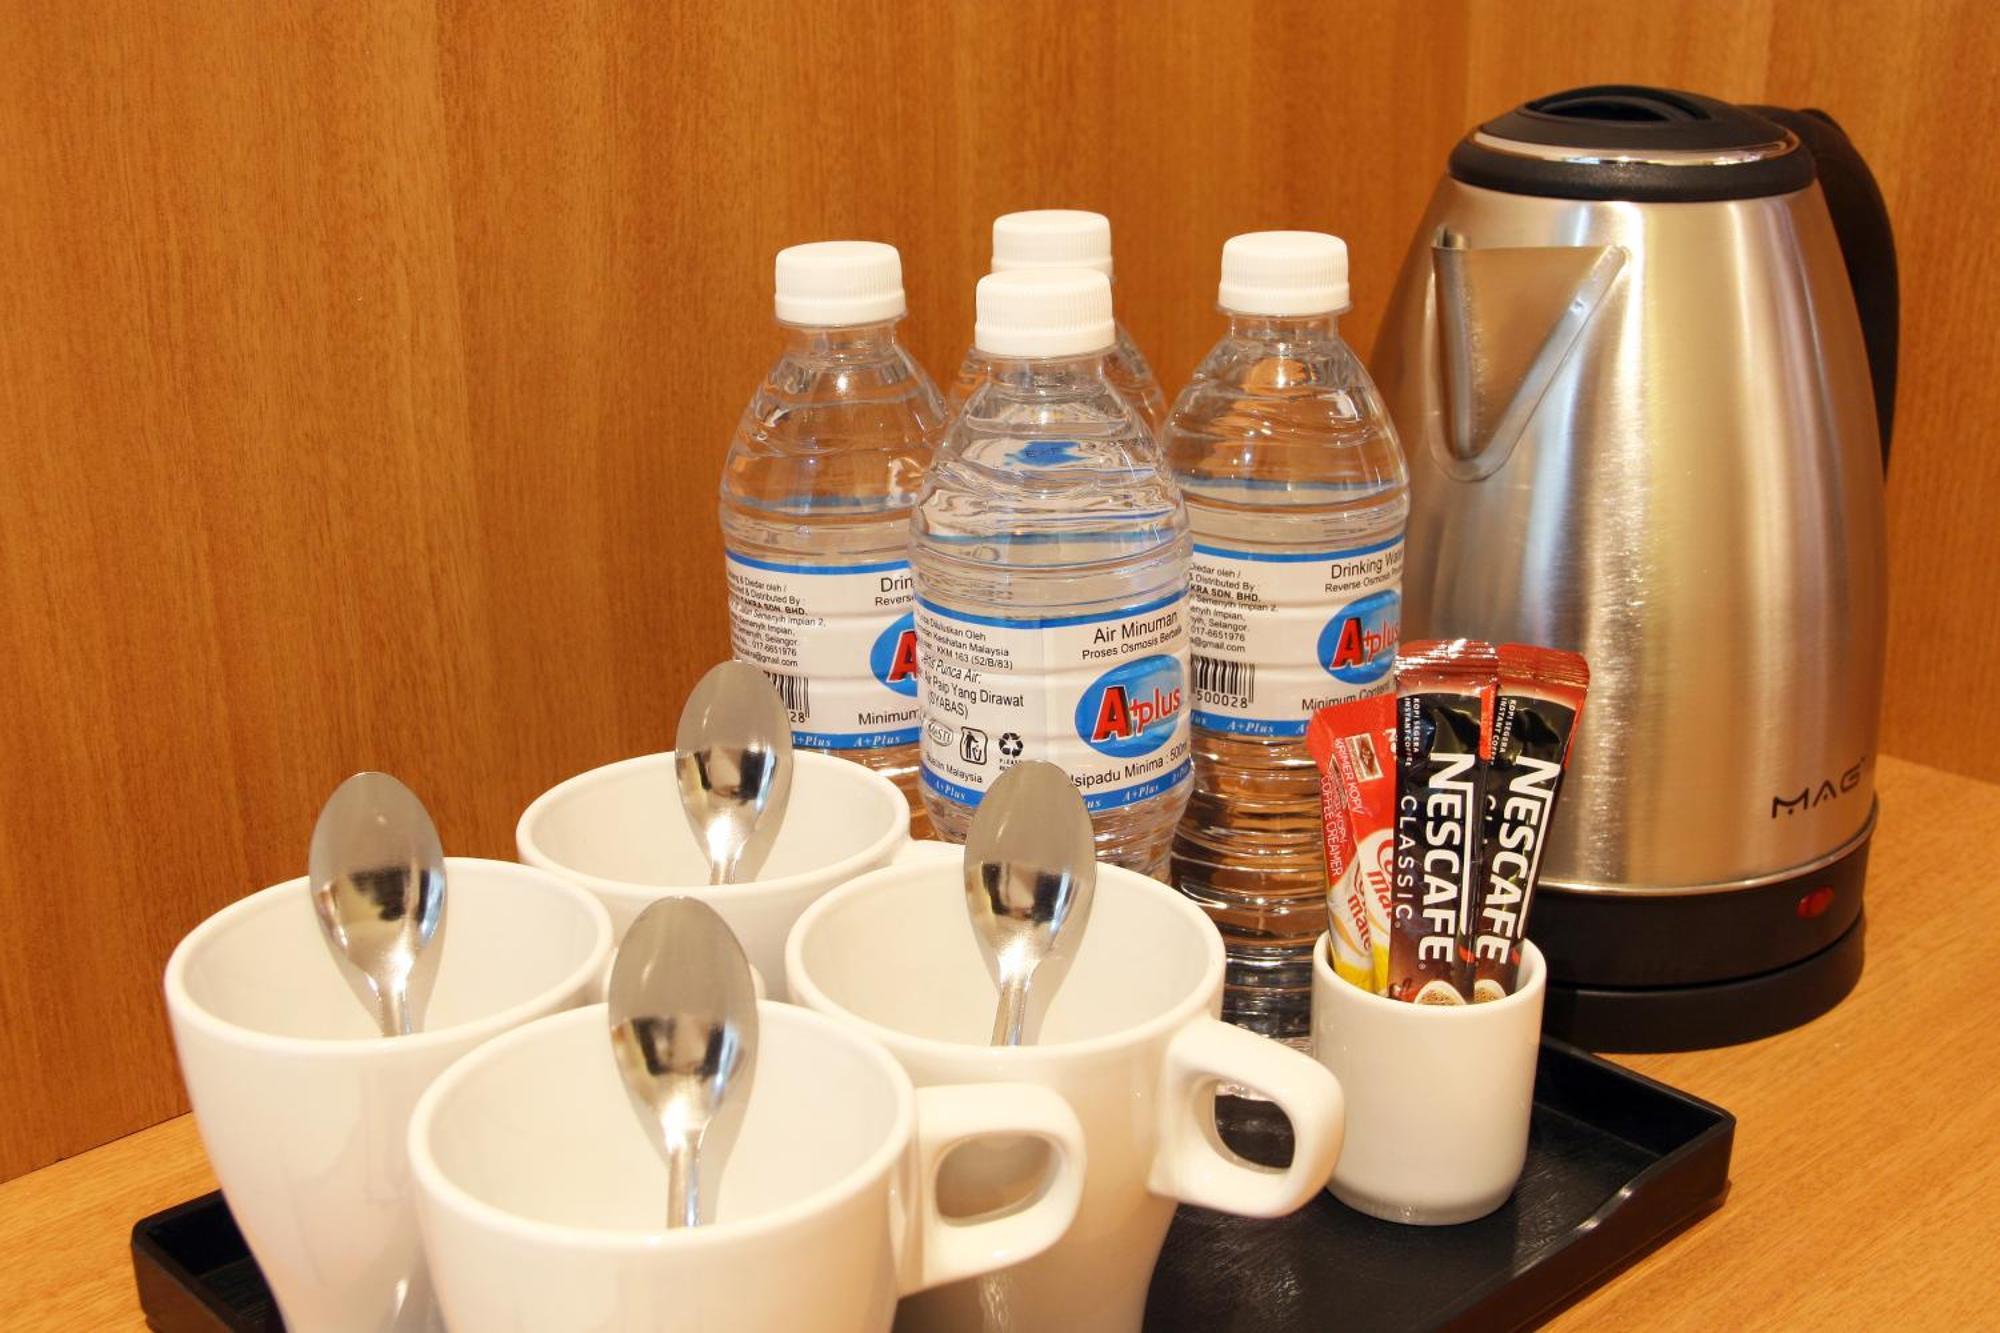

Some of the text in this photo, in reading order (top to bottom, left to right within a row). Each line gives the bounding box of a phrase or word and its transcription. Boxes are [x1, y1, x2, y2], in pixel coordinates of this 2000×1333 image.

[1217, 567, 1235, 578] oleh
[1331, 558, 1383, 580] Drinking
[1195, 574, 1240, 590] Distributed
[1242, 582, 1255, 593] By
[1325, 581, 1361, 593] Reverse
[789, 596, 800, 606] By
[1237, 592, 1260, 602] BHD.
[785, 607, 808, 616] BHD.
[965, 629, 986, 641] Oleh
[1093, 610, 1178, 644] Air Minuman
[955, 651, 968, 662] 163
[969, 641, 1009, 657] Malaysia
[1082, 646, 1118, 660] Proses
[1121, 636, 1158, 653] Osmosis
[936, 660, 961, 680] Punca
[952, 684, 977, 704] Yang
[980, 689, 1024, 707] Dirawat
[1197, 690, 1249, 709] 500028
[1302, 694, 1356, 711] Minimum
[1227, 720, 1274, 734] A+Plus
[1500, 699, 1517, 753] KOPI SEGERA
[853, 735, 900, 748] A+Plus
[946, 764, 983, 783] Malaysia
[1125, 756, 1163, 778] Minima
[1772, 757, 1865, 819] MAG
[1326, 820, 1344, 876] CREAMER
